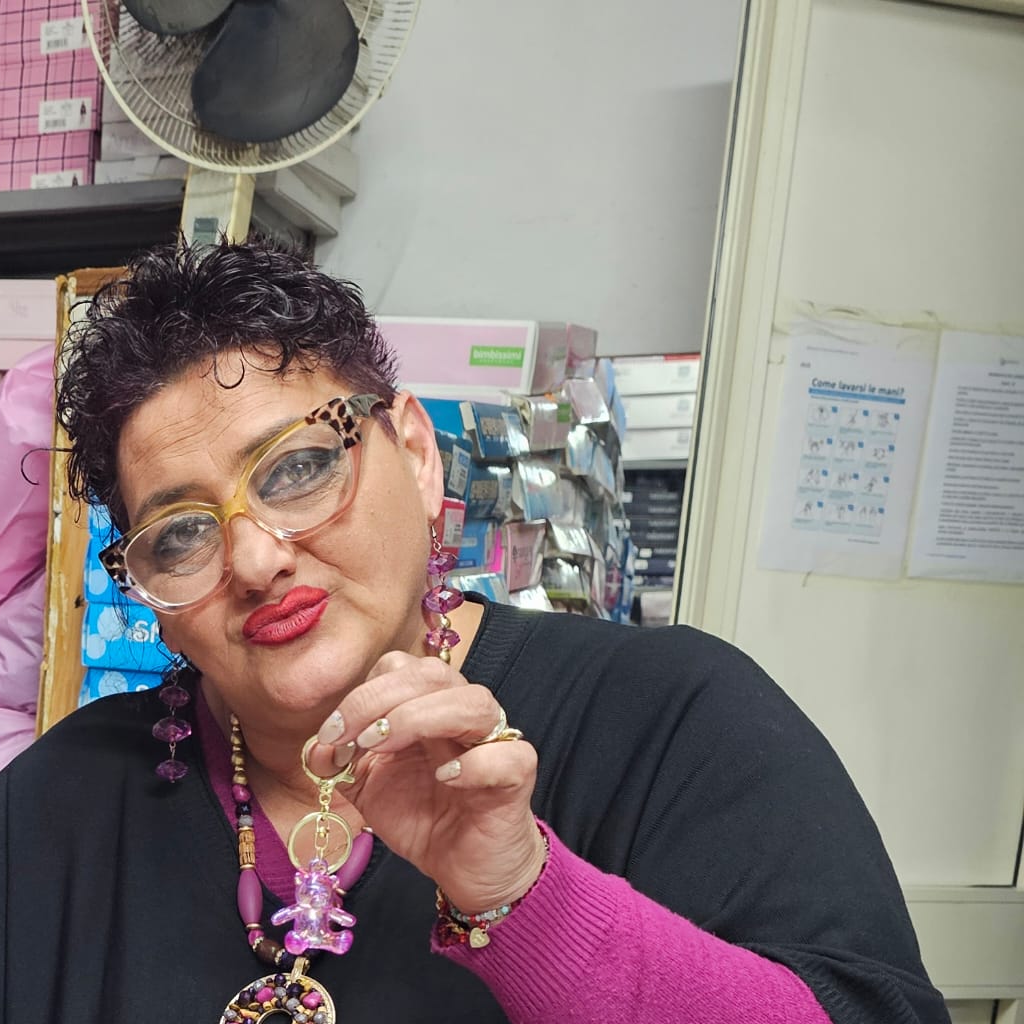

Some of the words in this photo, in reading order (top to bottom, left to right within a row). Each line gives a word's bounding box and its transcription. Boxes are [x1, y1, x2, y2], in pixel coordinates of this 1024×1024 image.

[811, 378, 837, 389] Come
[838, 381, 867, 392] lavarsi
[878, 387, 905, 396] mani?
